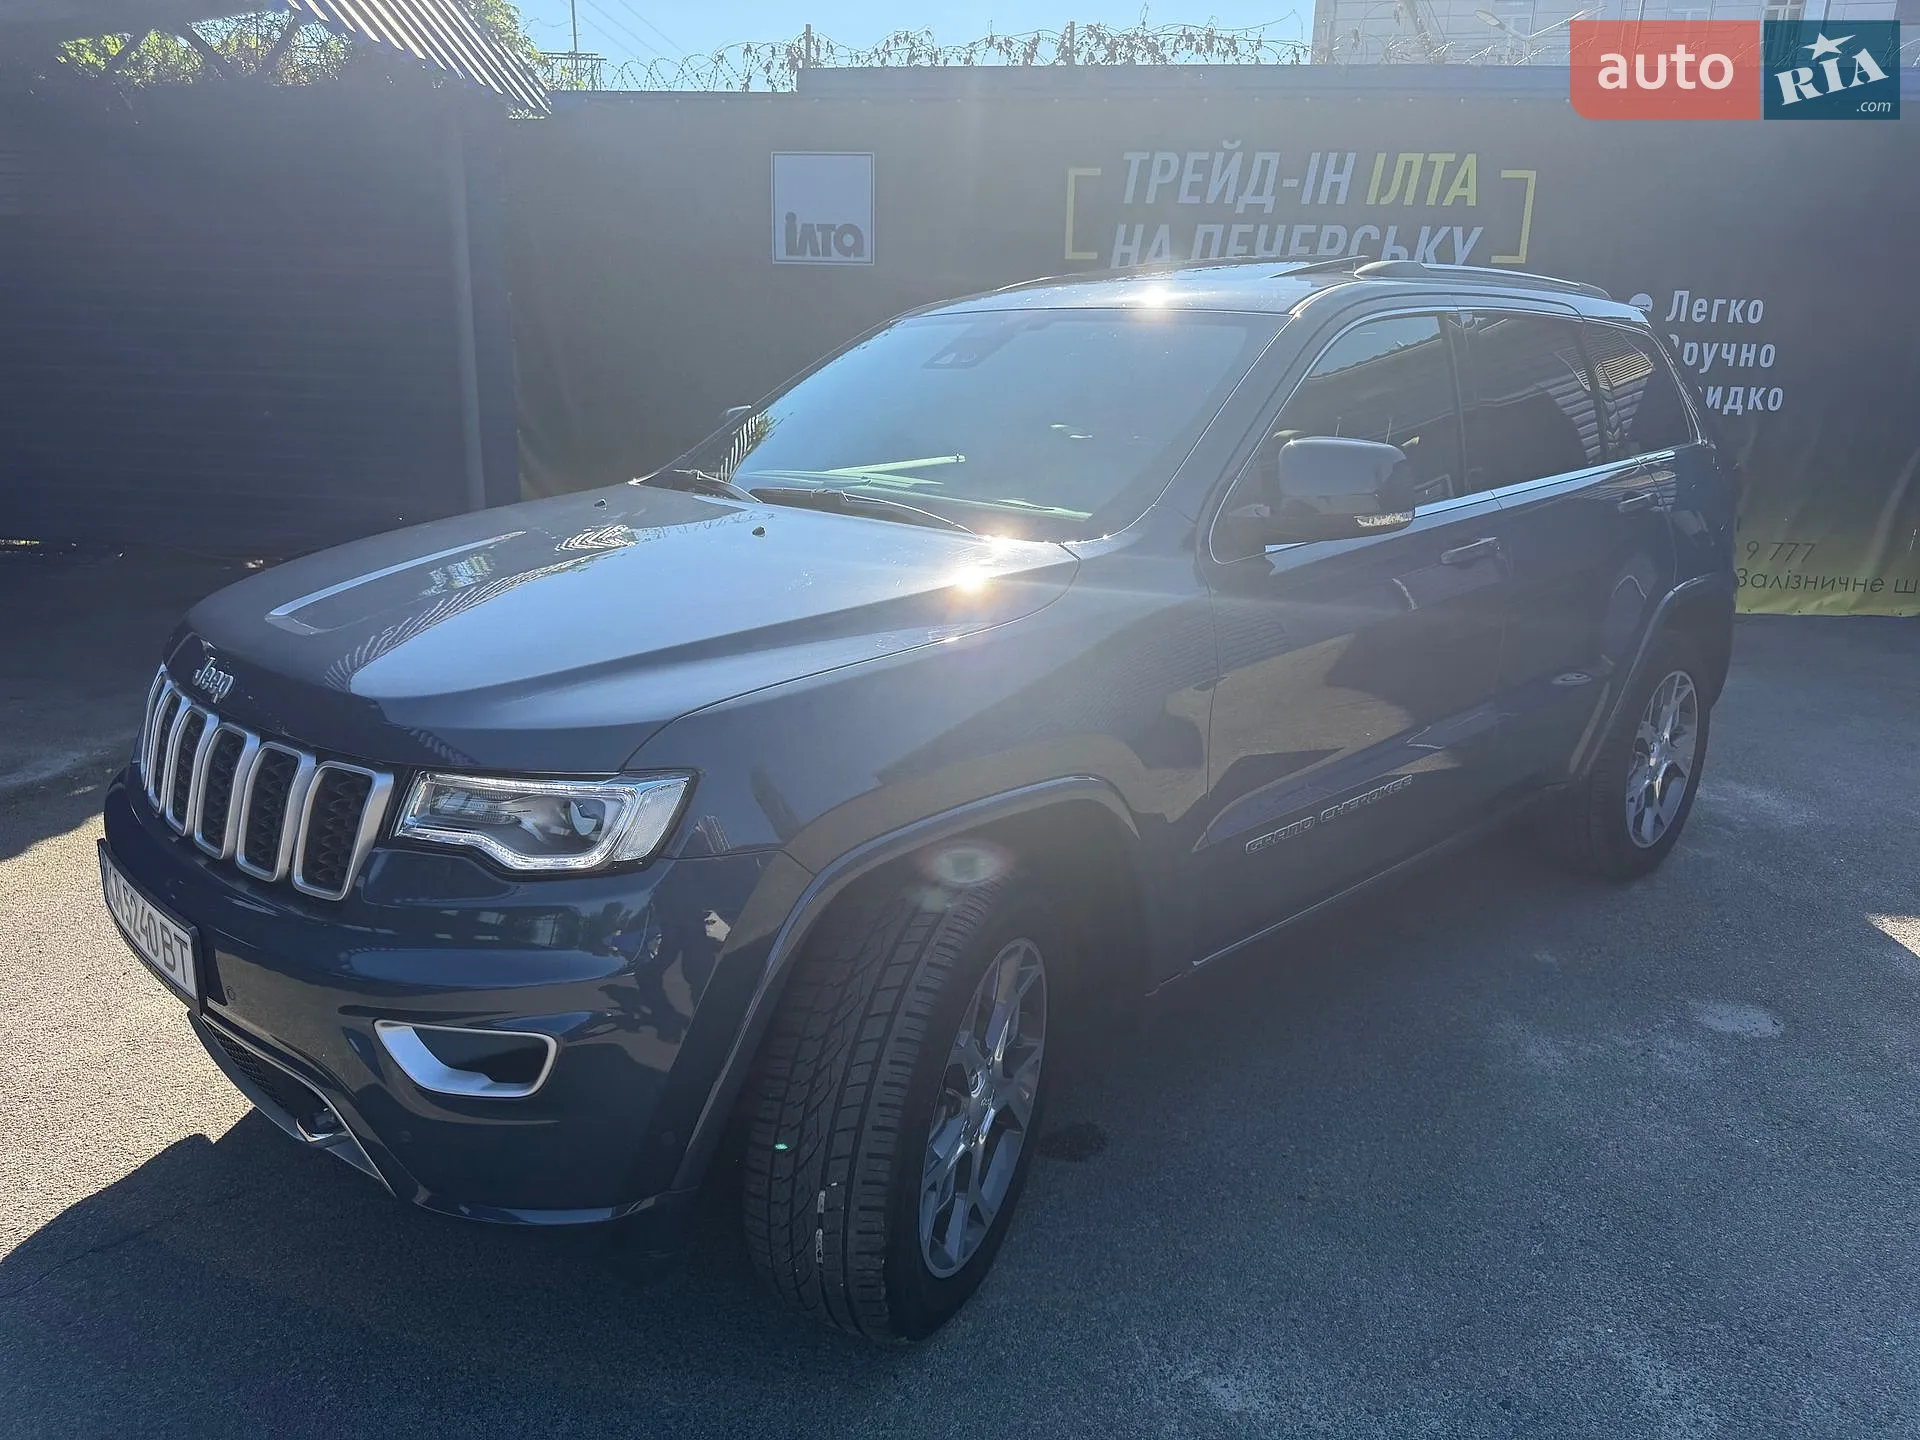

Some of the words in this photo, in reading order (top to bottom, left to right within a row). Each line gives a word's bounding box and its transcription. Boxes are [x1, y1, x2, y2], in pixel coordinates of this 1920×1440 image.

[1121, 140, 1357, 214] ТРЕЙД-ІН
[1364, 152, 1479, 207] ІЛТА
[1109, 223, 1172, 270] НА
[1665, 289, 1765, 325] Легко
[1668, 333, 1777, 374] ручно
[1698, 385, 1785, 416] идко
[1768, 542, 1817, 563] 777
[1736, 567, 1885, 593] Залізничне
[192, 656, 234, 704] Jeep
